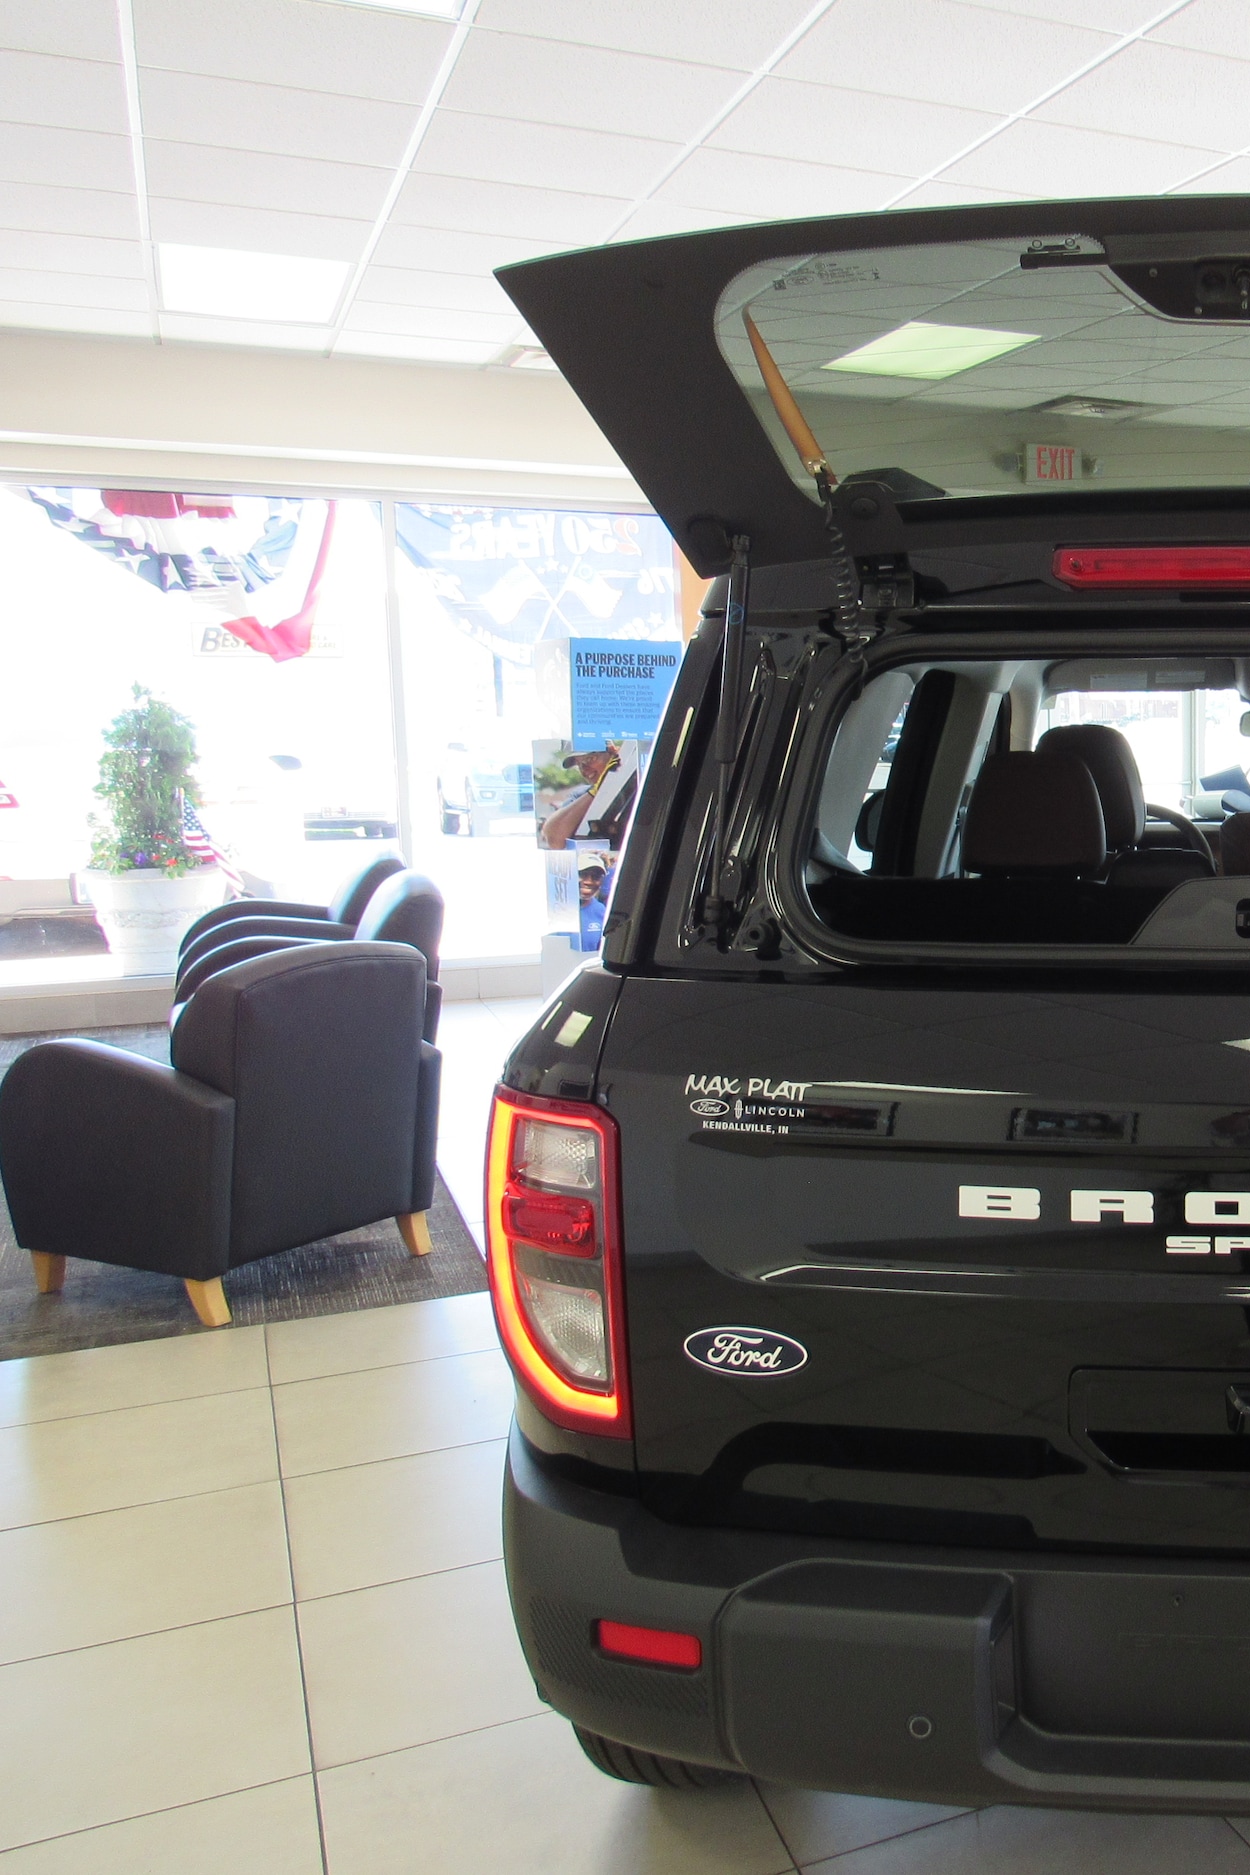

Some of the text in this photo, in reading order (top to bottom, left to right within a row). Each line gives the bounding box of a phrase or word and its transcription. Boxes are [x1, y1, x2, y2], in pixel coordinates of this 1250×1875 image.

[1036, 446, 1075, 480] EXIT
[575, 652, 677, 667] A PURPOSE BEHIND
[575, 665, 655, 679] THE PURCHASE
[685, 1074, 813, 1101] MAX PLATT
[745, 1106, 805, 1118] LINCOLN
[702, 1120, 789, 1135] KENDALLVILLE, IN
